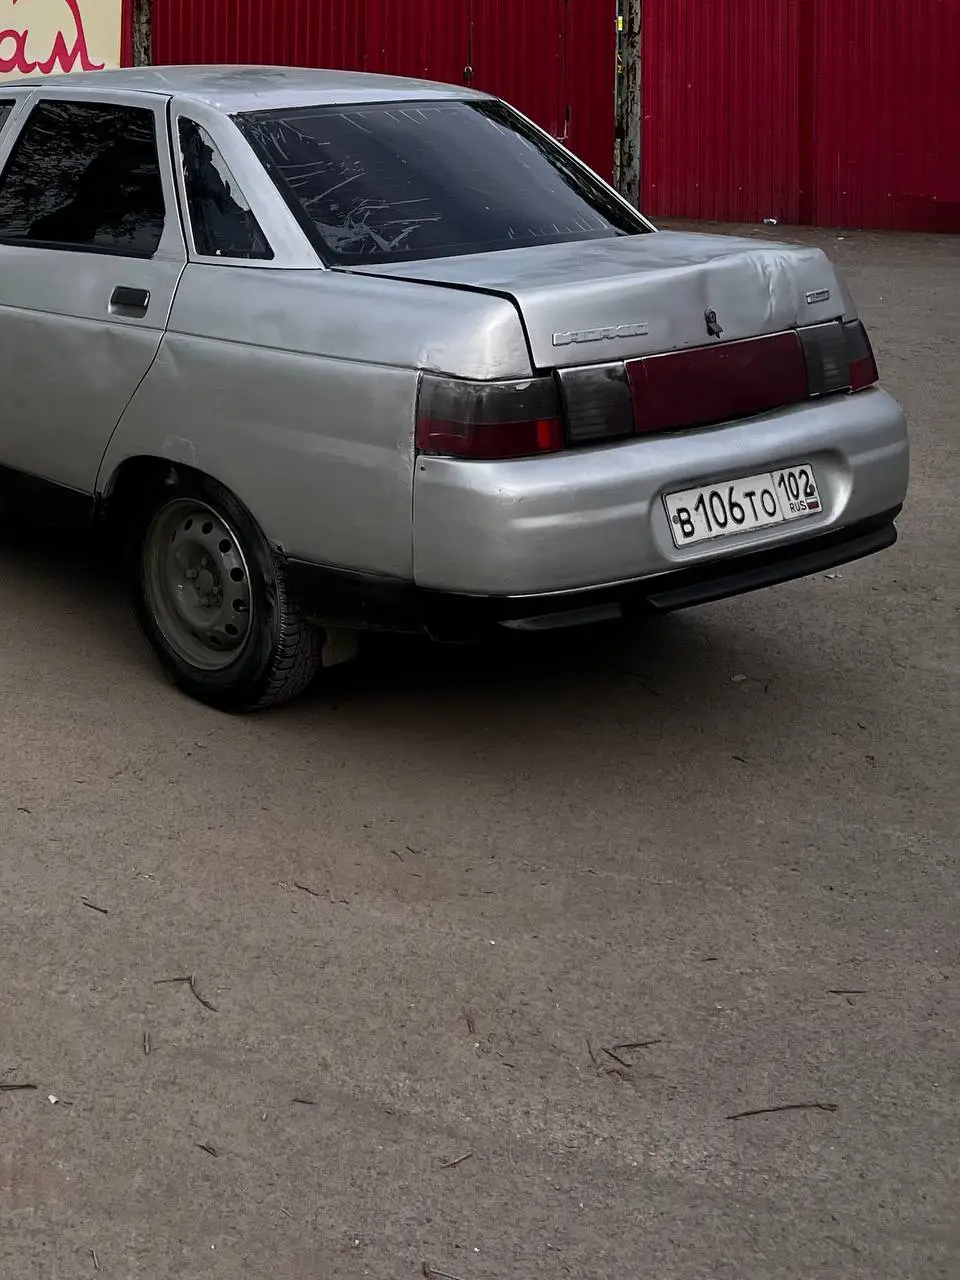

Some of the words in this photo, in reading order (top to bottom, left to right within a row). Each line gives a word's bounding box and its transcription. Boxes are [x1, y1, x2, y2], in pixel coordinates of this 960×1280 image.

[676, 486, 777, 539] В106ТО
[778, 469, 811, 503] 102
[789, 500, 807, 514] RUS
